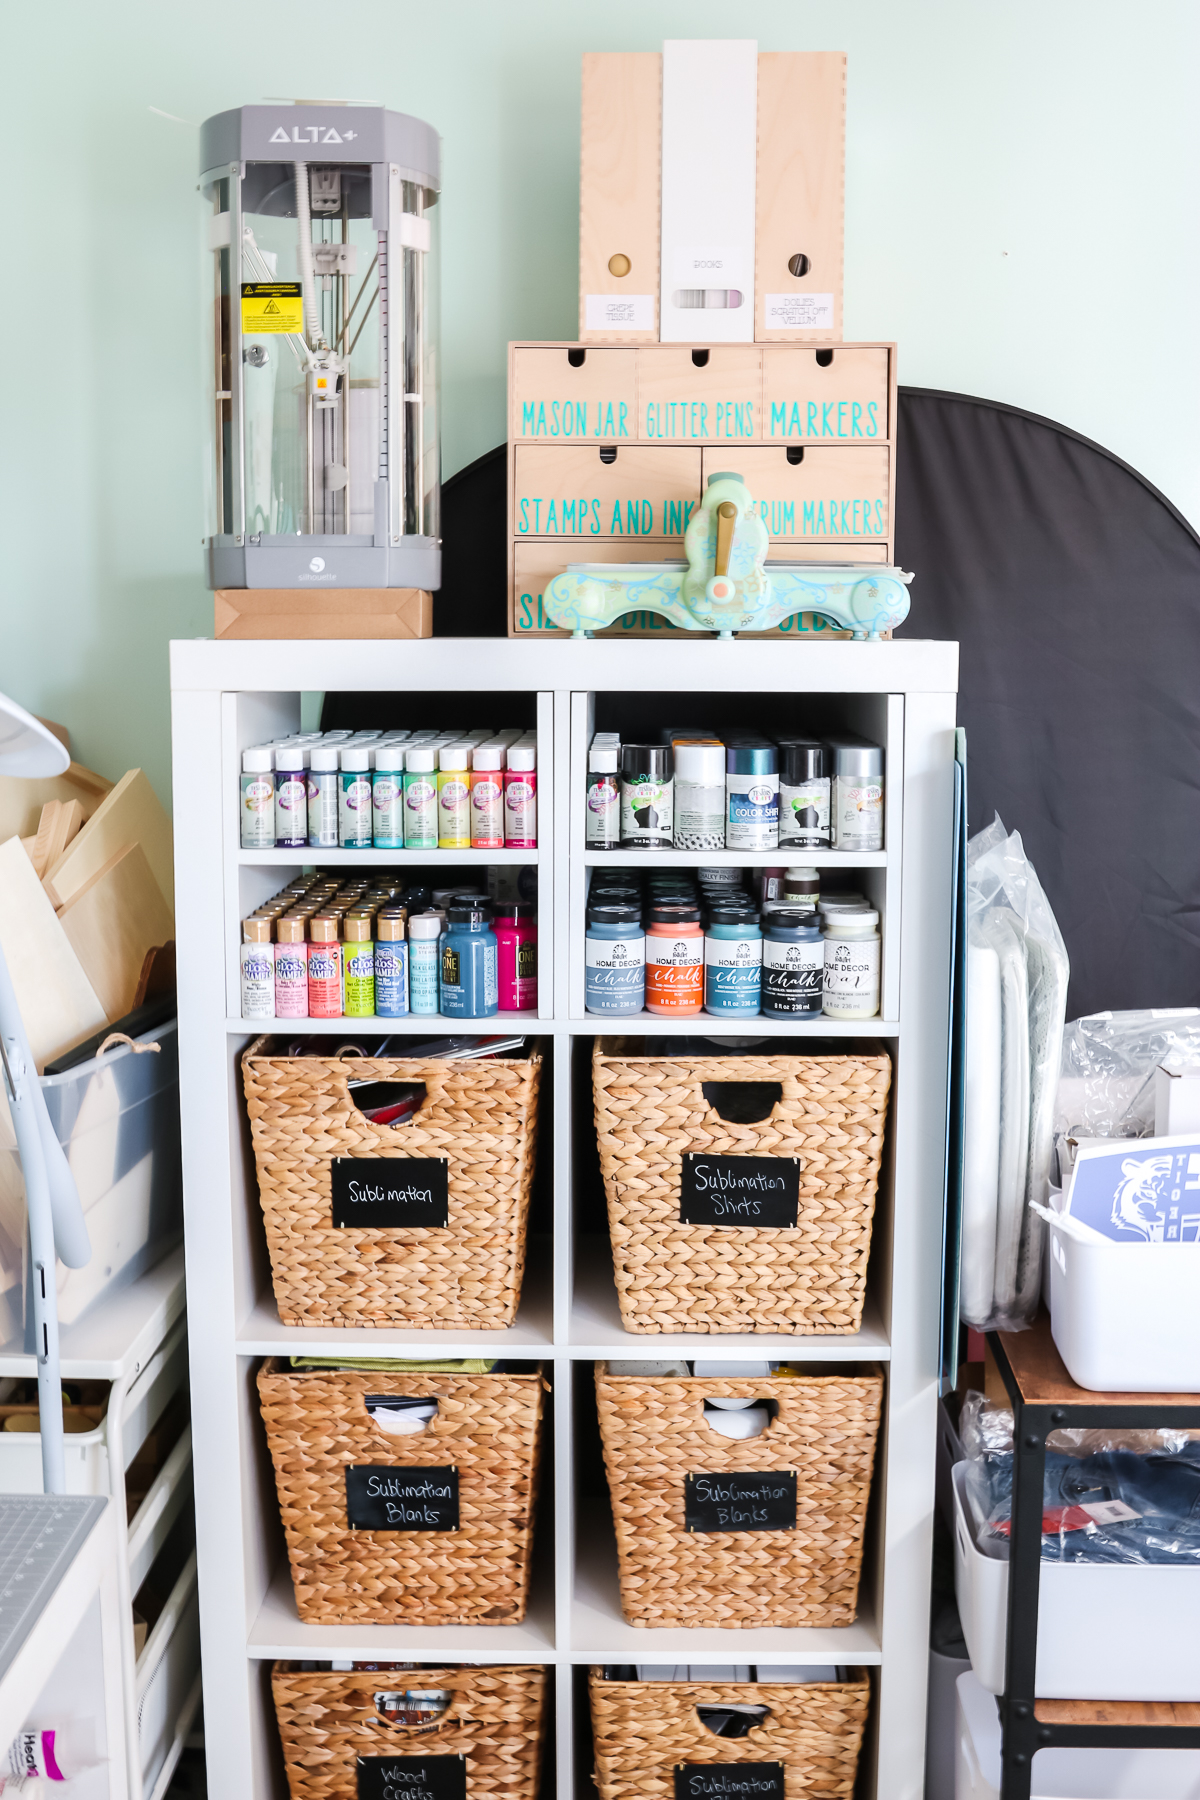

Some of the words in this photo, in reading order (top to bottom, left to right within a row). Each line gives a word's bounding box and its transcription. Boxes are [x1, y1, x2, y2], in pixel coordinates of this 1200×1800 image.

[268, 126, 358, 143] ALTA+
[693, 260, 723, 269] BOOKS
[606, 303, 635, 312] CREPE
[771, 307, 809, 316] SCRATCH
[605, 312, 635, 322] TISSUE
[781, 316, 817, 325] VELLUM
[522, 401, 587, 437] MASON
[594, 401, 628, 437] JAR
[646, 402, 708, 437] GLITTER
[716, 402, 754, 438] PENS
[770, 401, 879, 438] MARKERS
[519, 498, 601, 534] STAMPS
[610, 499, 653, 535] AND
[803, 499, 884, 535] MARKERS
[735, 808, 763, 817] COLOR
[244, 960, 271, 971] GLOSS
[443, 956, 457, 970] ONE
[519, 951, 534, 963] ONE
[619, 959, 641, 968] DECOR
[656, 957, 676, 965] HOME
[679, 957, 701, 965] DECOR
[652, 966, 703, 983] chalk
[771, 962, 790, 970] HOME
[824, 962, 838, 970] OME
[842, 964, 870, 972] DECOR
[592, 967, 645, 986] chalk
[714, 967, 761, 984] chalk
[768, 971, 823, 988] chalk
[694, 1165, 785, 1191] Sublimation
[348, 1180, 433, 1203] Sublimation
[710, 1193, 762, 1216] Shirts
[366, 1475, 452, 1499] Sublimation
[695, 1479, 788, 1502] Sublimation
[385, 1502, 440, 1524] Blanks
[716, 1504, 768, 1525] Blanks
[380, 1765, 427, 1784] Wood
[382, 1785, 435, 1800] Crafts
[689, 1775, 778, 1795] Sublimation
